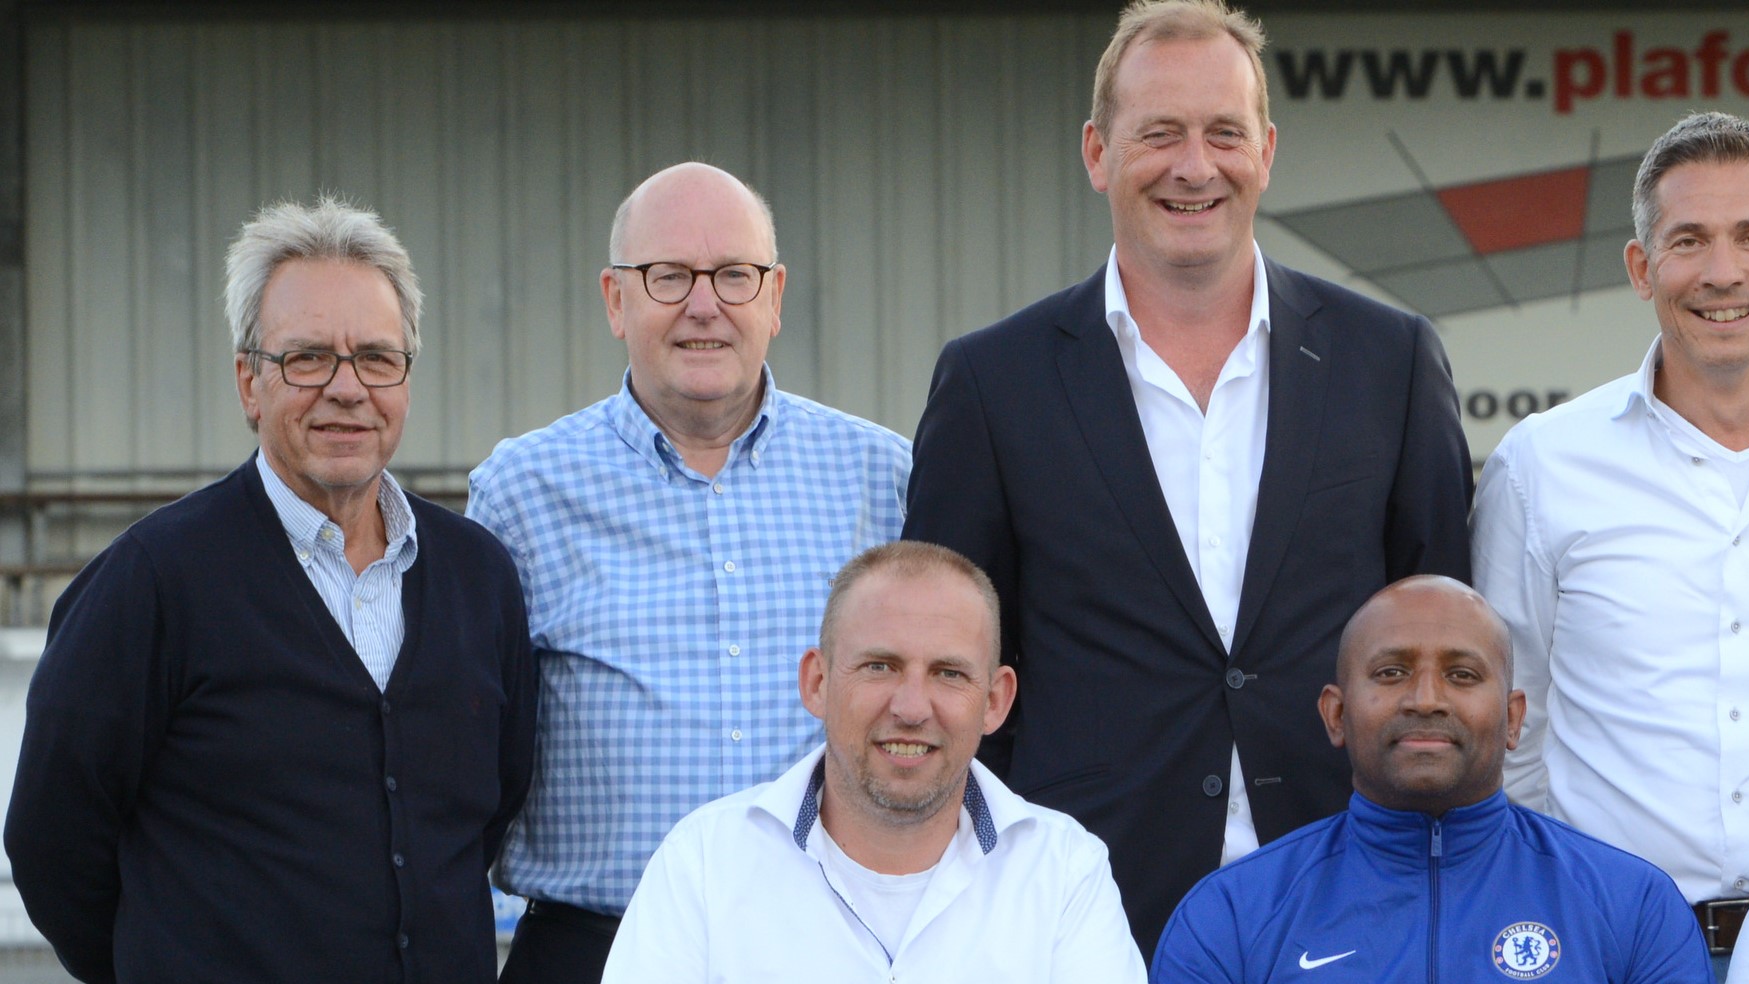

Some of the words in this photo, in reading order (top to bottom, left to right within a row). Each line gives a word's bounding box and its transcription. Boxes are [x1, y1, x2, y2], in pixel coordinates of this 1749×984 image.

[1464, 388, 1569, 420] oor
[1502, 924, 1545, 938] CHELSEA
[1505, 967, 1535, 978] FOOTBALL
[1536, 963, 1550, 974] CLUB
